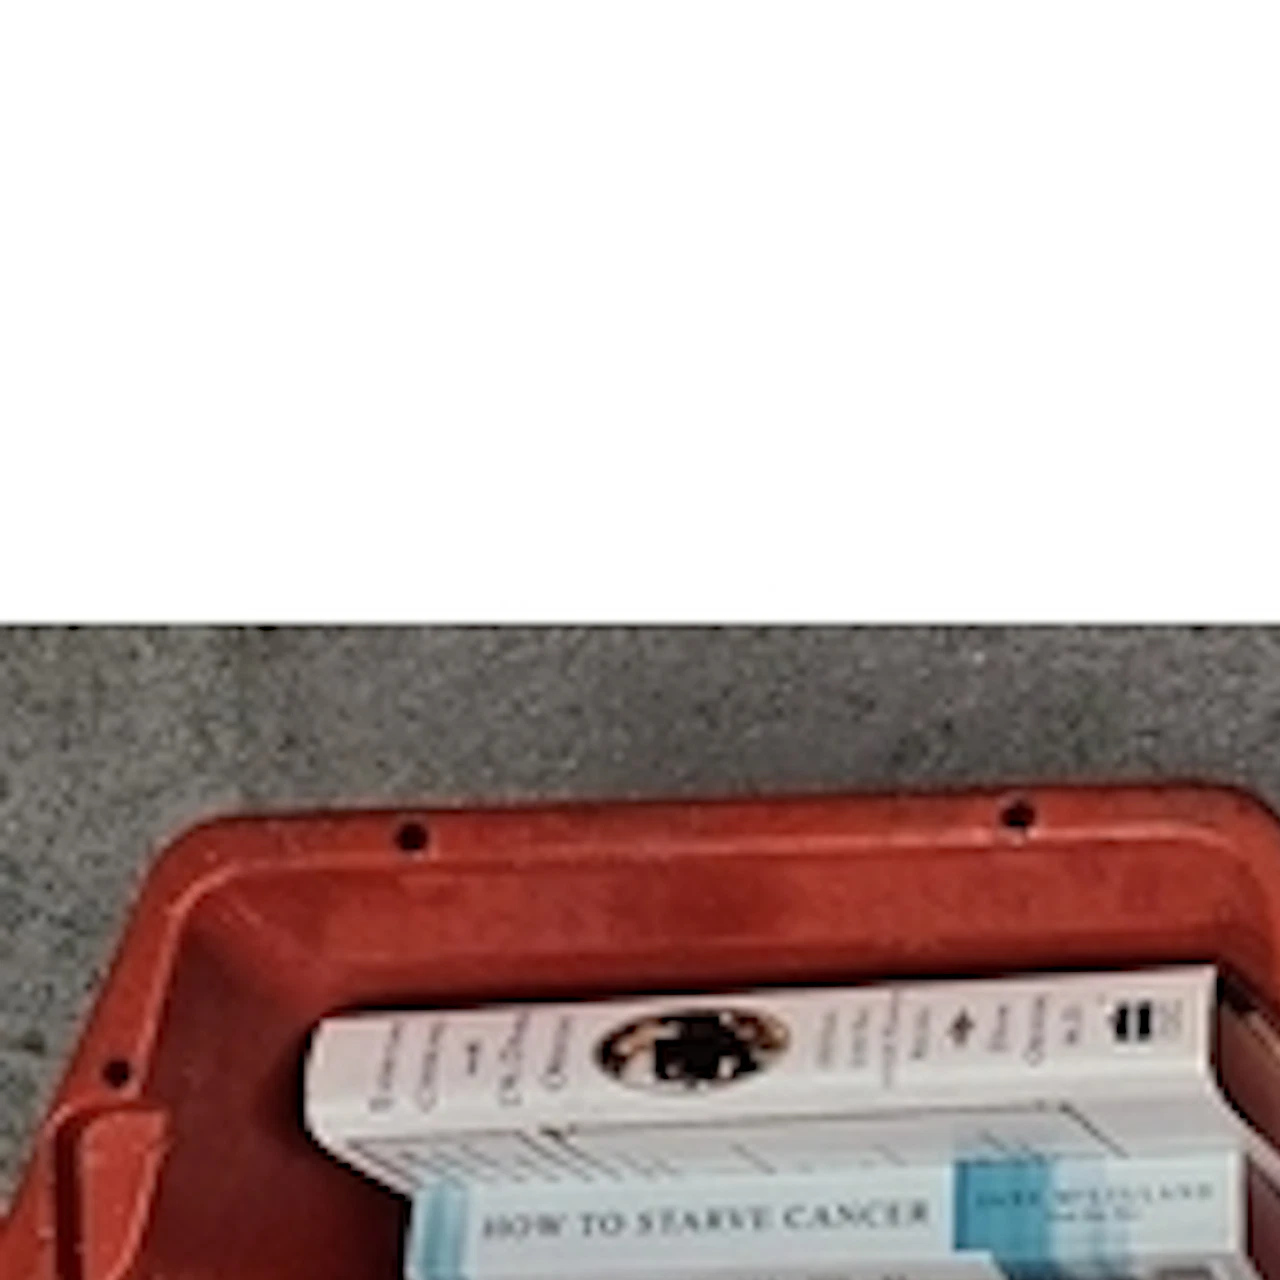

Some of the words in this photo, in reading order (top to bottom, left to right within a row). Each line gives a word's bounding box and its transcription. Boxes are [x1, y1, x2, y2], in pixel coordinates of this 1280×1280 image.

[483, 1211, 567, 1240] HOW
[578, 1210, 624, 1238] TO
[637, 1204, 771, 1236] STARVE
[783, 1199, 932, 1231] CANCER
